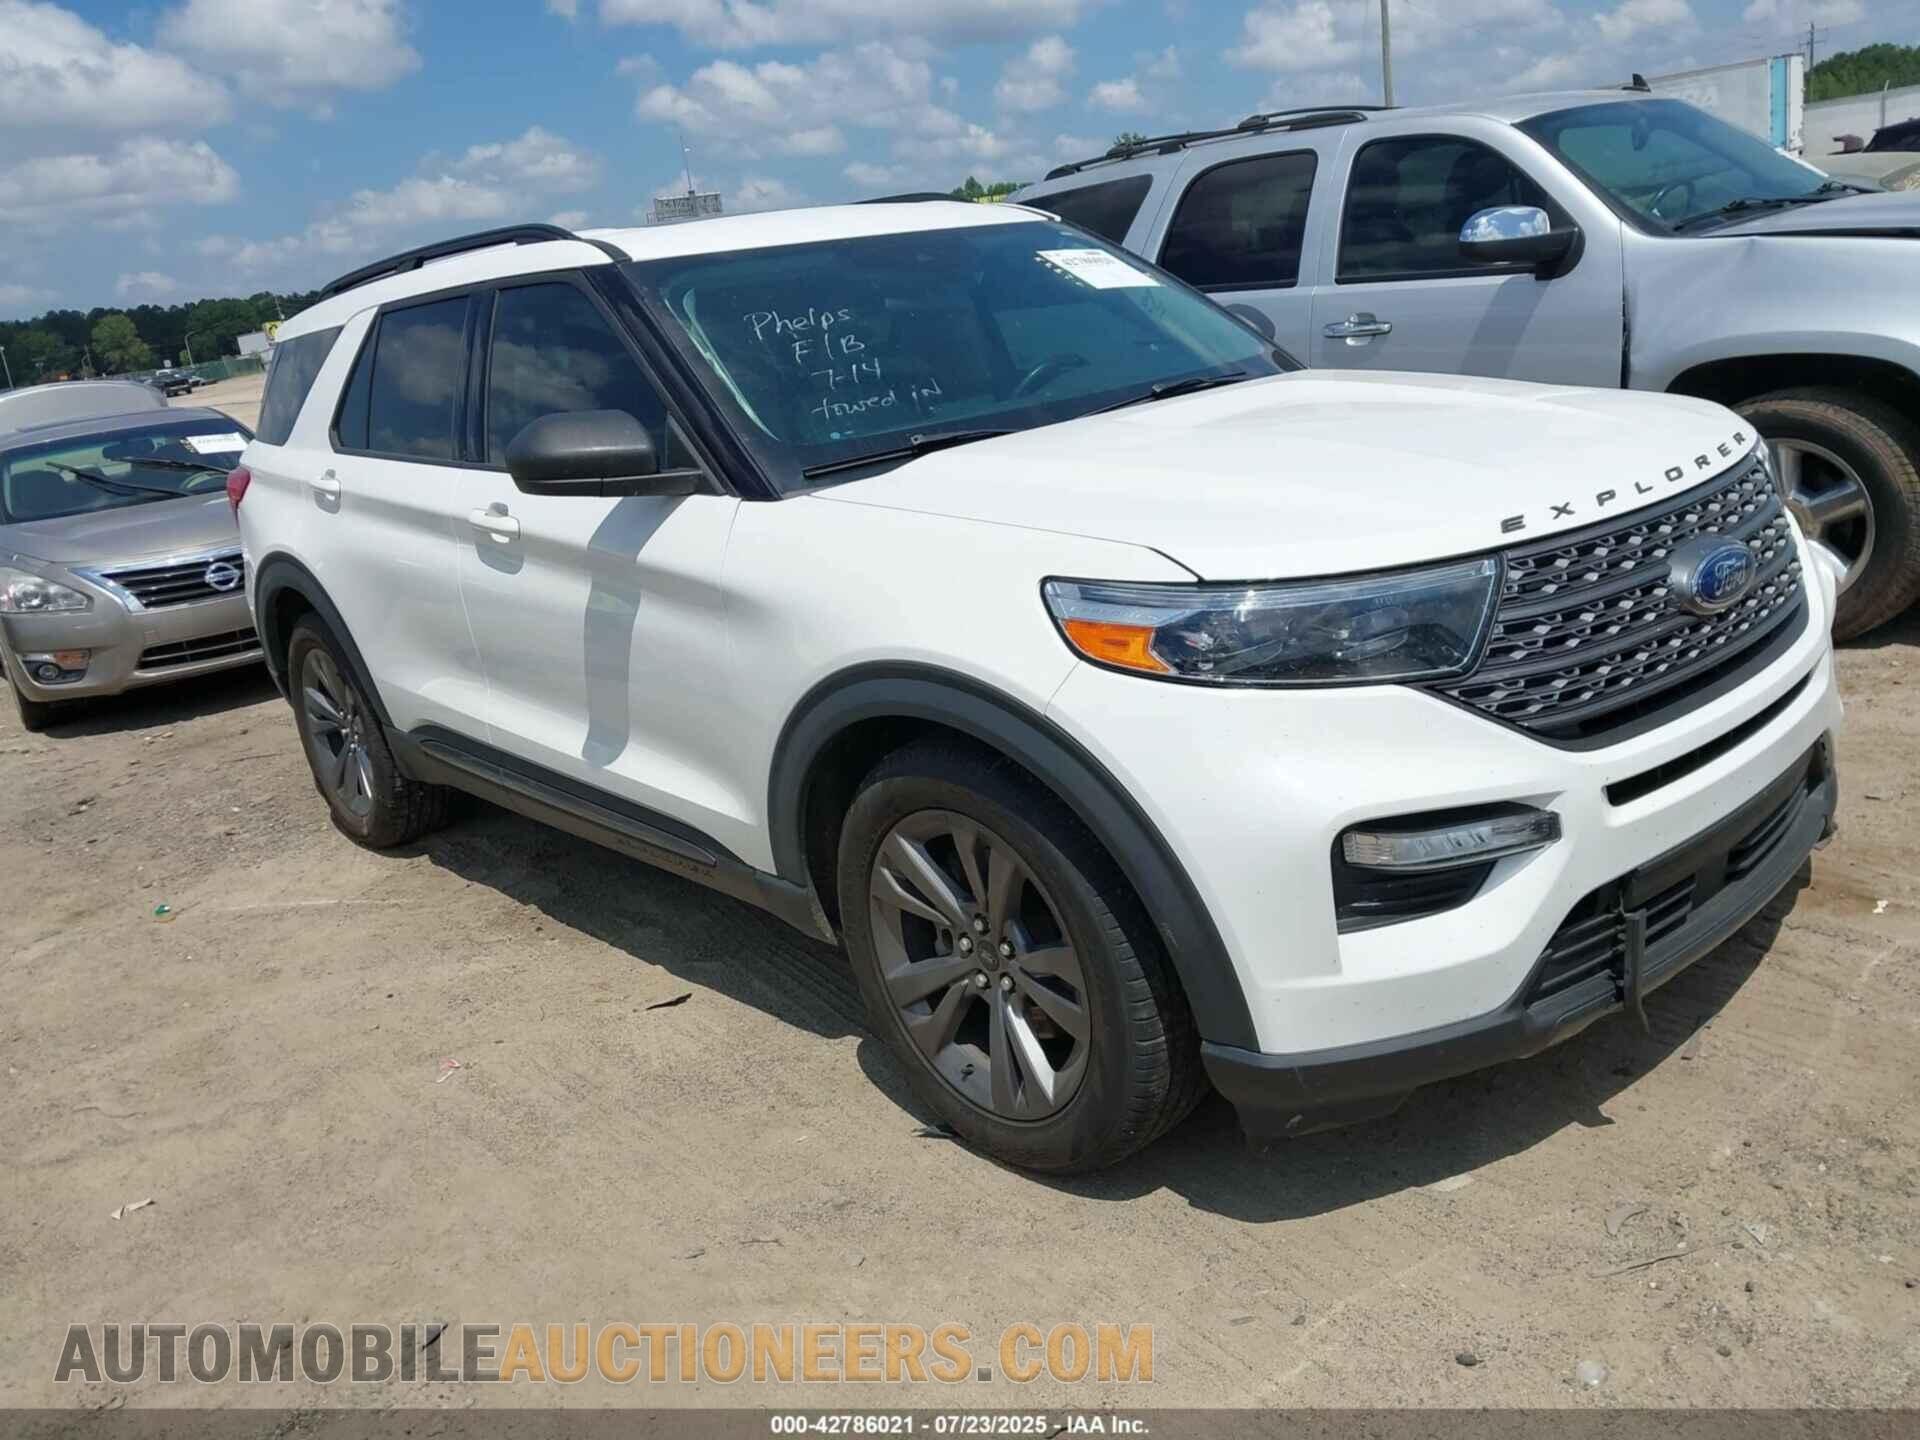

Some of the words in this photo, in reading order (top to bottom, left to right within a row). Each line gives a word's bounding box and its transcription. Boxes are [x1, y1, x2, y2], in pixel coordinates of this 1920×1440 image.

[744, 307, 851, 341] Phelps
[811, 357, 881, 390] 7-14
[1500, 431, 1747, 534] EXPLORER
